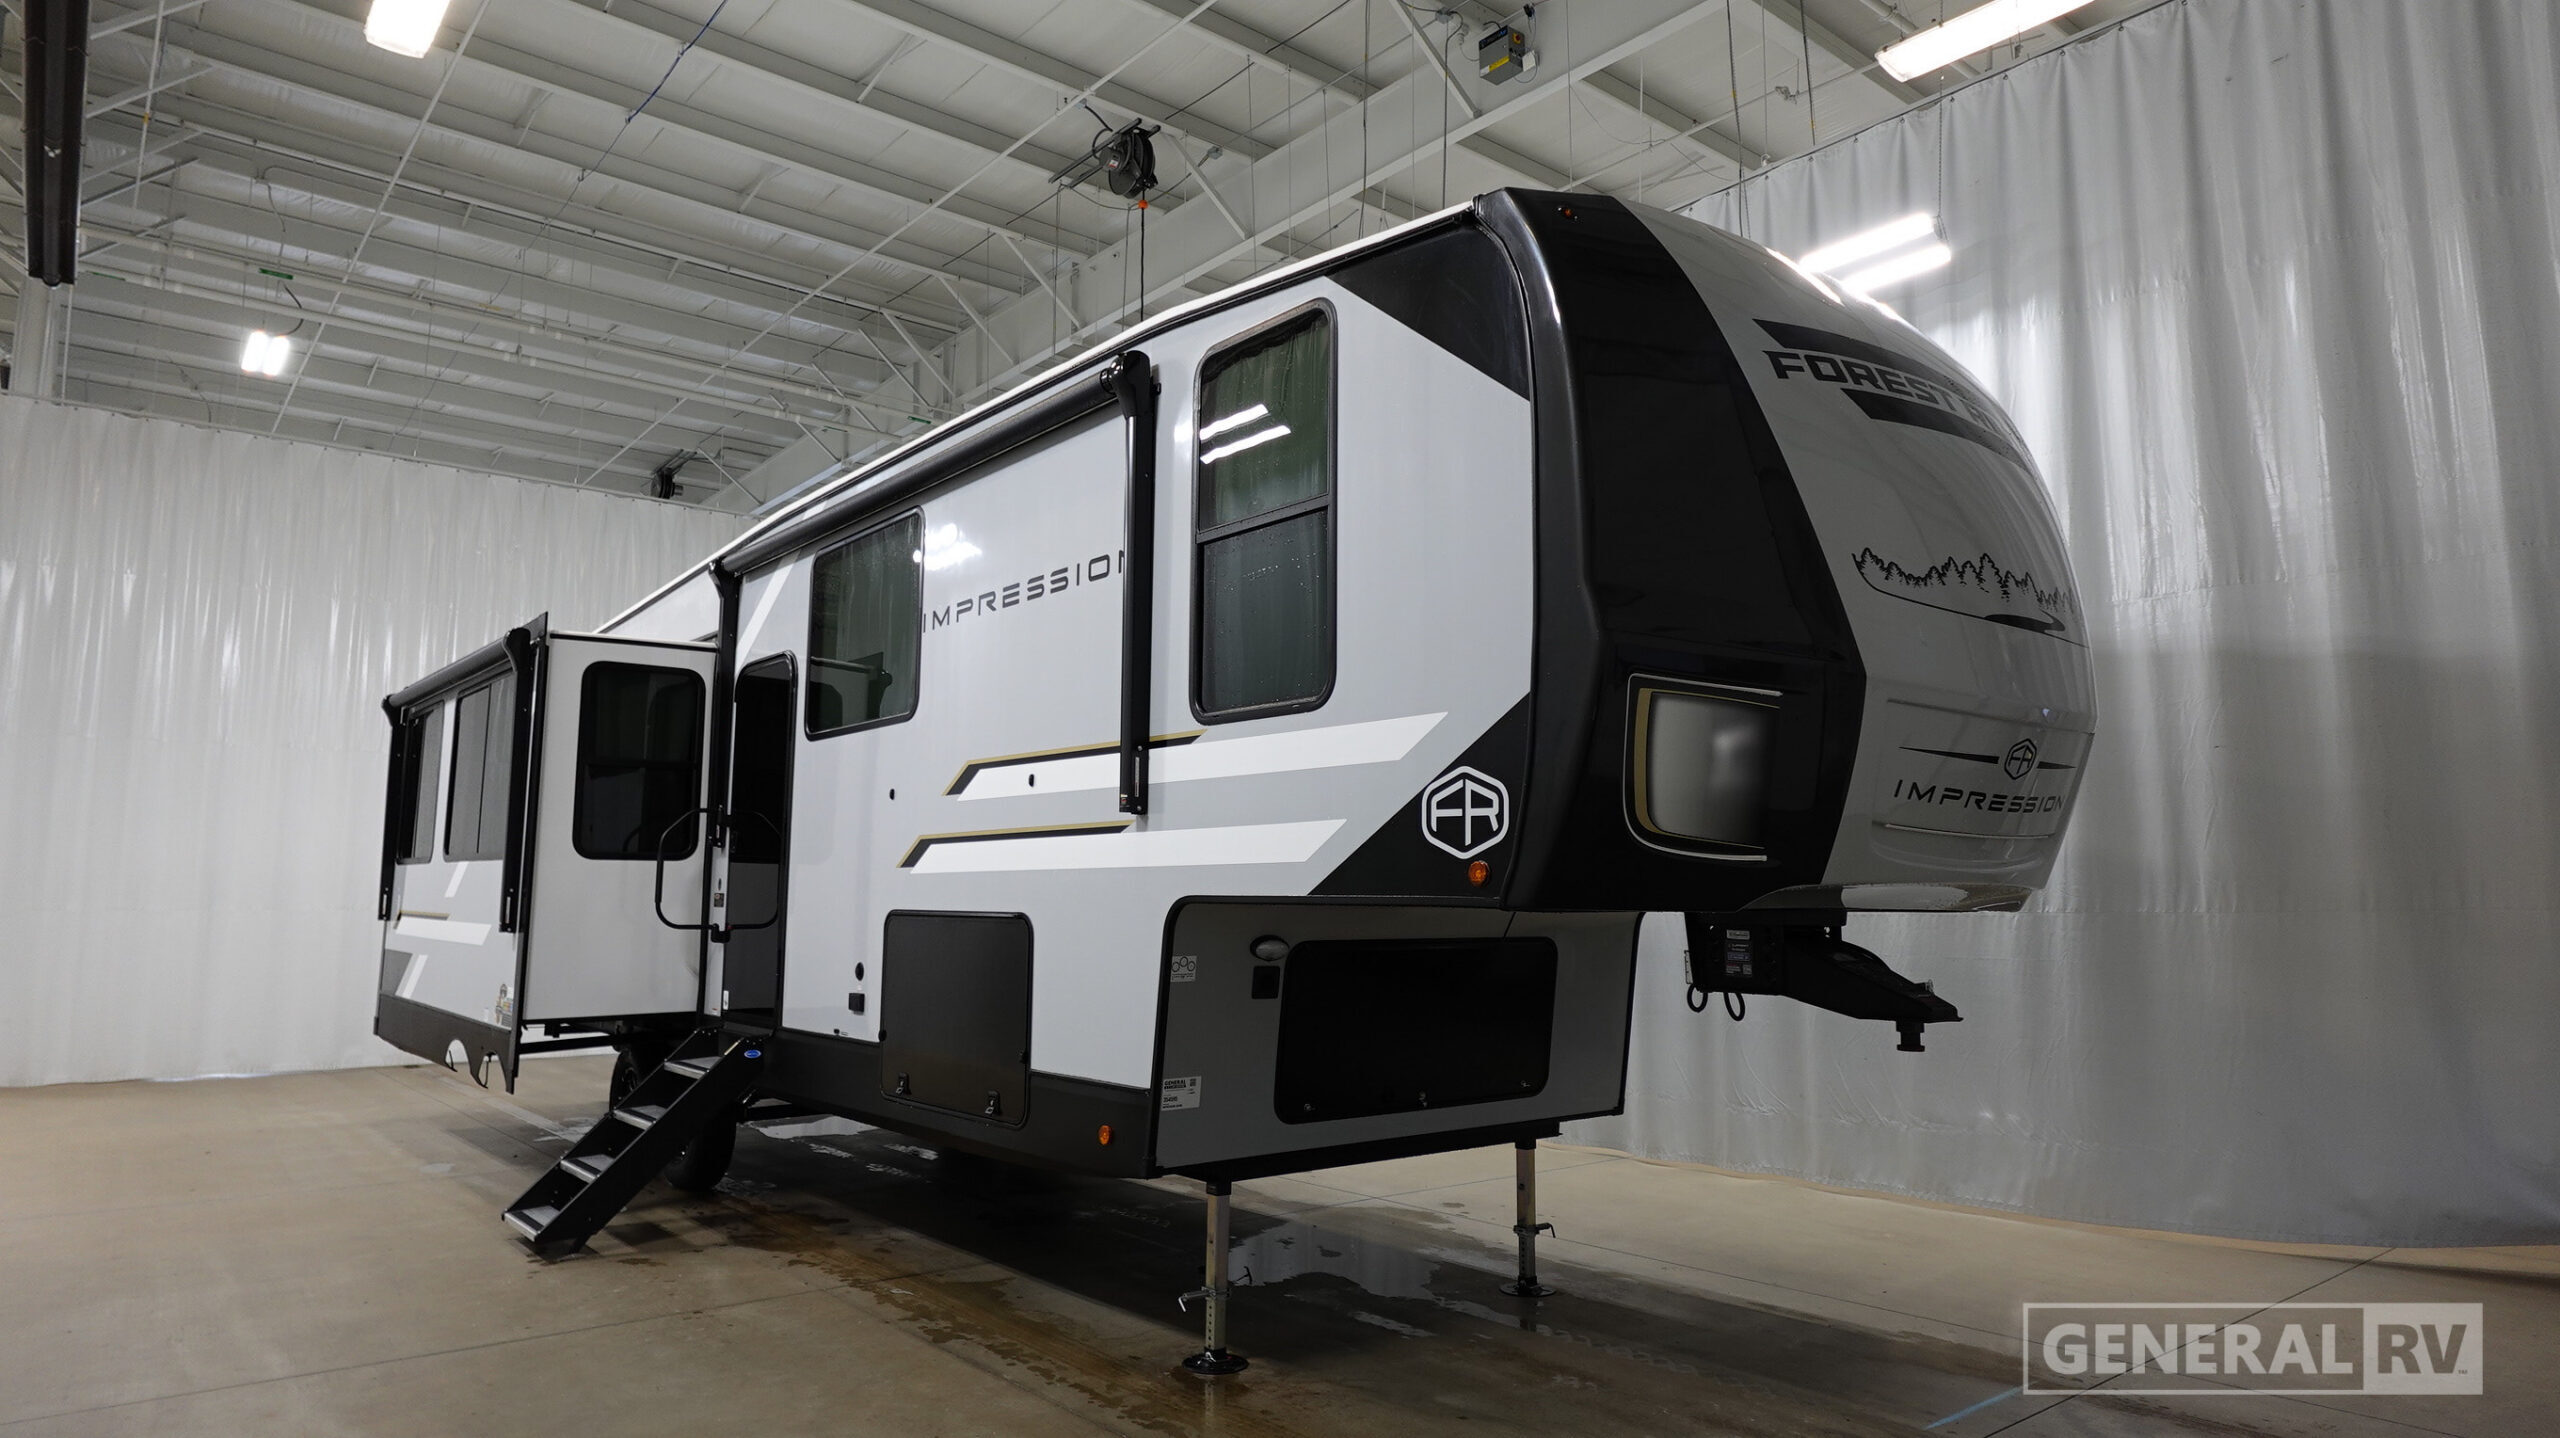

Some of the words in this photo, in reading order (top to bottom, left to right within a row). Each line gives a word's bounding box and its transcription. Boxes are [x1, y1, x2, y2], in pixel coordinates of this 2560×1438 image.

[1762, 350, 1958, 412] FOREST
[922, 549, 1125, 634] IMPRESSIO
[1429, 777, 1501, 848] FR
[1893, 779, 2066, 814] IMPRESSION
